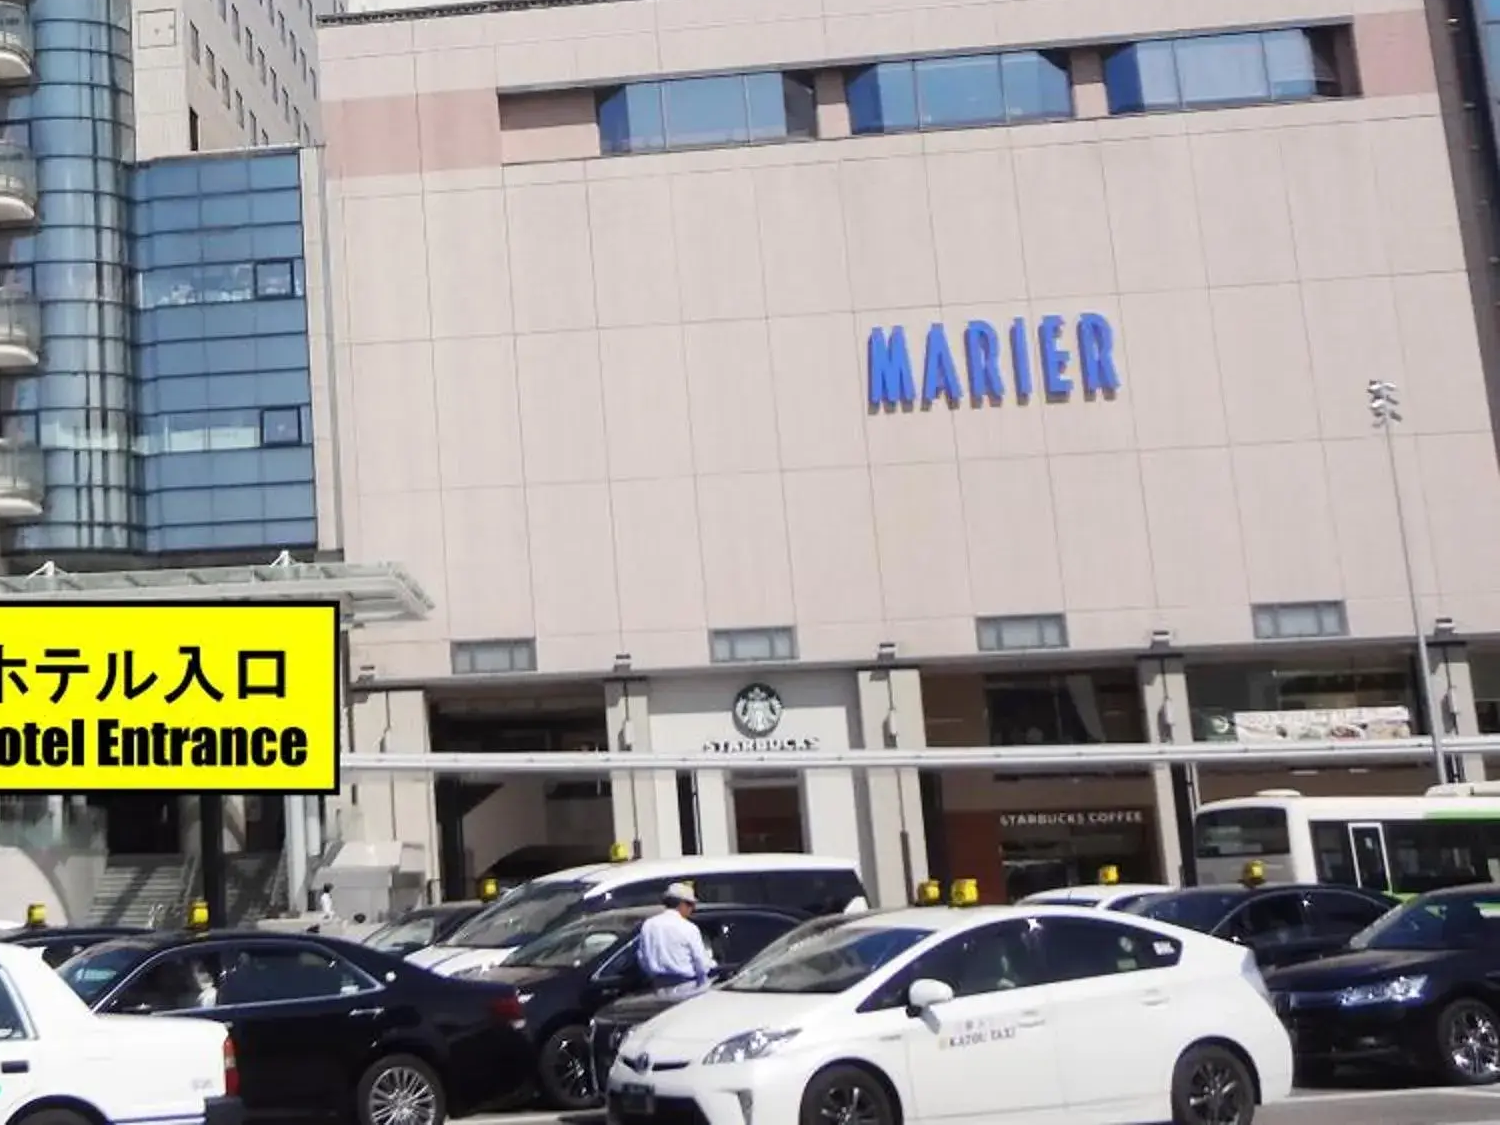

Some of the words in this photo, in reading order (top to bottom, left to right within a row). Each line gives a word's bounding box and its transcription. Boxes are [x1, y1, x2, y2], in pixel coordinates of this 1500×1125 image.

[867, 312, 1121, 414] MARIER
[1000, 813, 1085, 826] STARBUCKS
[1088, 810, 1143, 824] COFFEE
